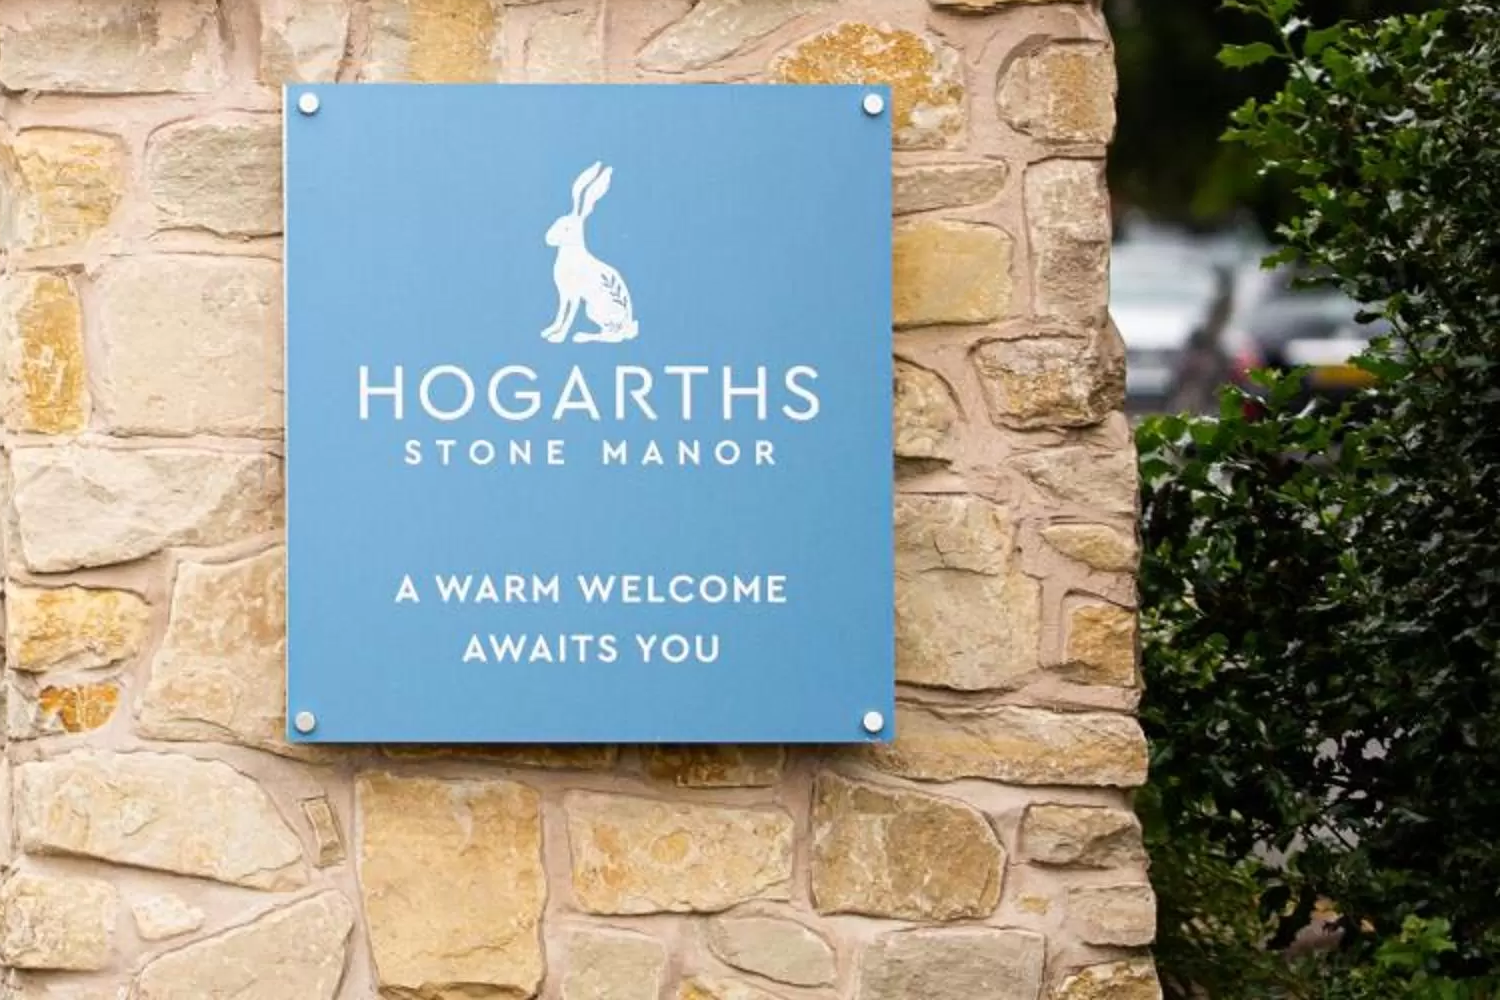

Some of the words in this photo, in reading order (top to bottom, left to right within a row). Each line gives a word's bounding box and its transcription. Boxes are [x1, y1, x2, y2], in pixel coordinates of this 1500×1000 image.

[357, 364, 821, 421] HOGARTHS
[404, 439, 565, 466] STONE
[602, 439, 777, 466] MANOR
[394, 574, 420, 603] A
[435, 574, 560, 603] WARM
[577, 574, 787, 603] WELCOME
[462, 634, 619, 663] AWAITS
[636, 634, 719, 663] YOU
